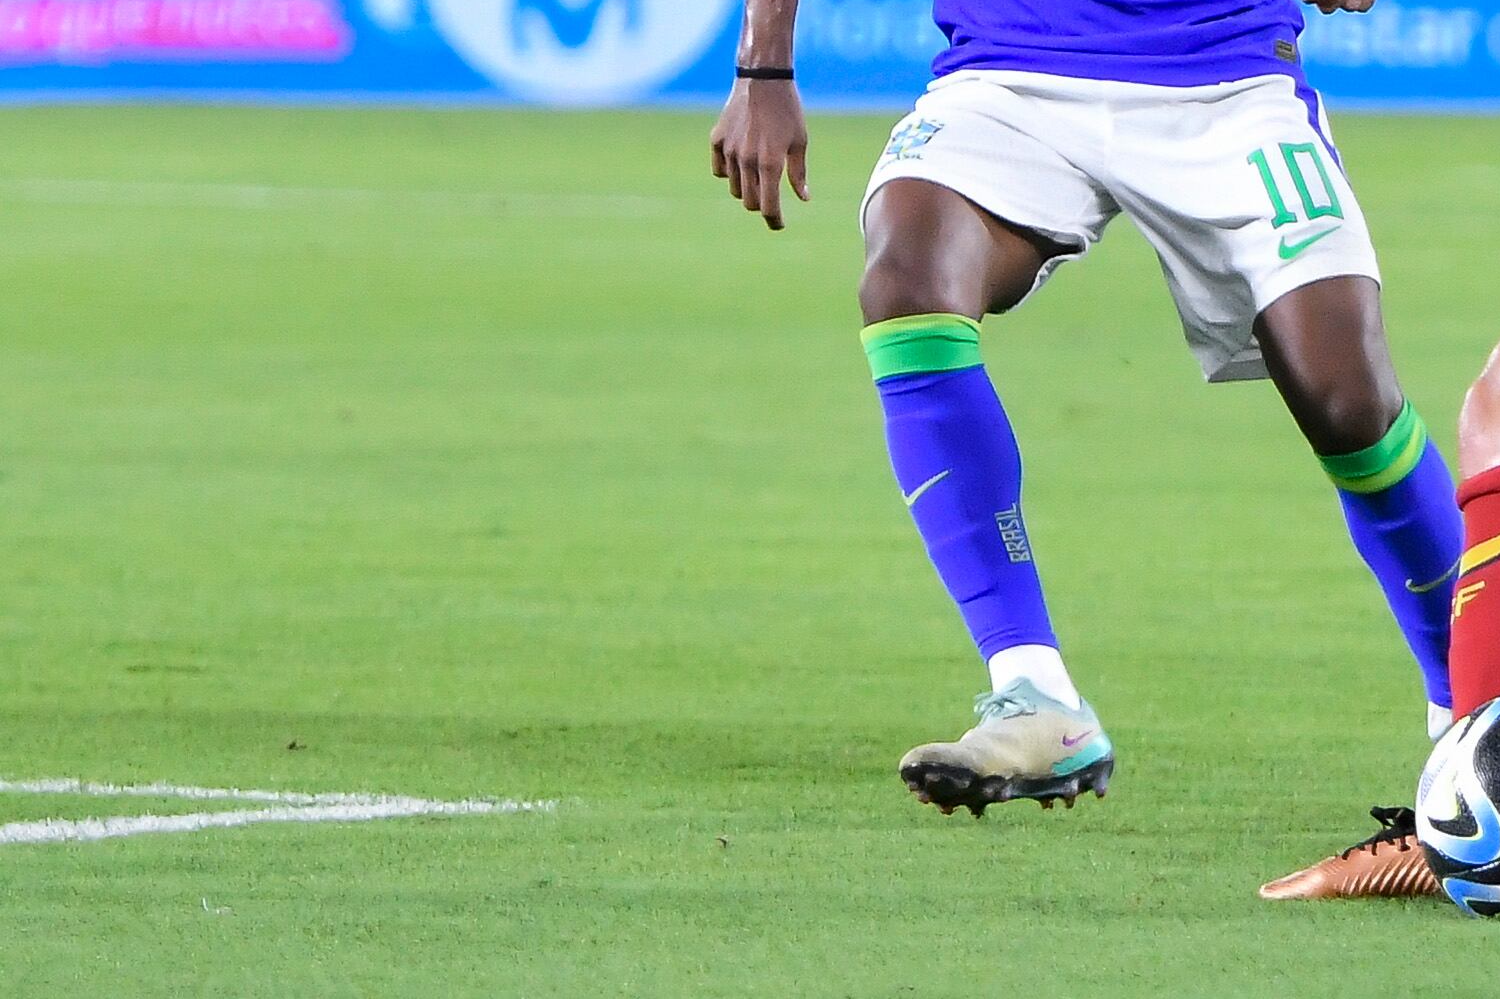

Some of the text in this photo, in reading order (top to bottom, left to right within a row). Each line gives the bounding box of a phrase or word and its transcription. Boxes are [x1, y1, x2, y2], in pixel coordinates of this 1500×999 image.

[1246, 142, 1344, 230] 10
[994, 502, 1032, 564] BRASIL
[1451, 580, 1486, 624] F
